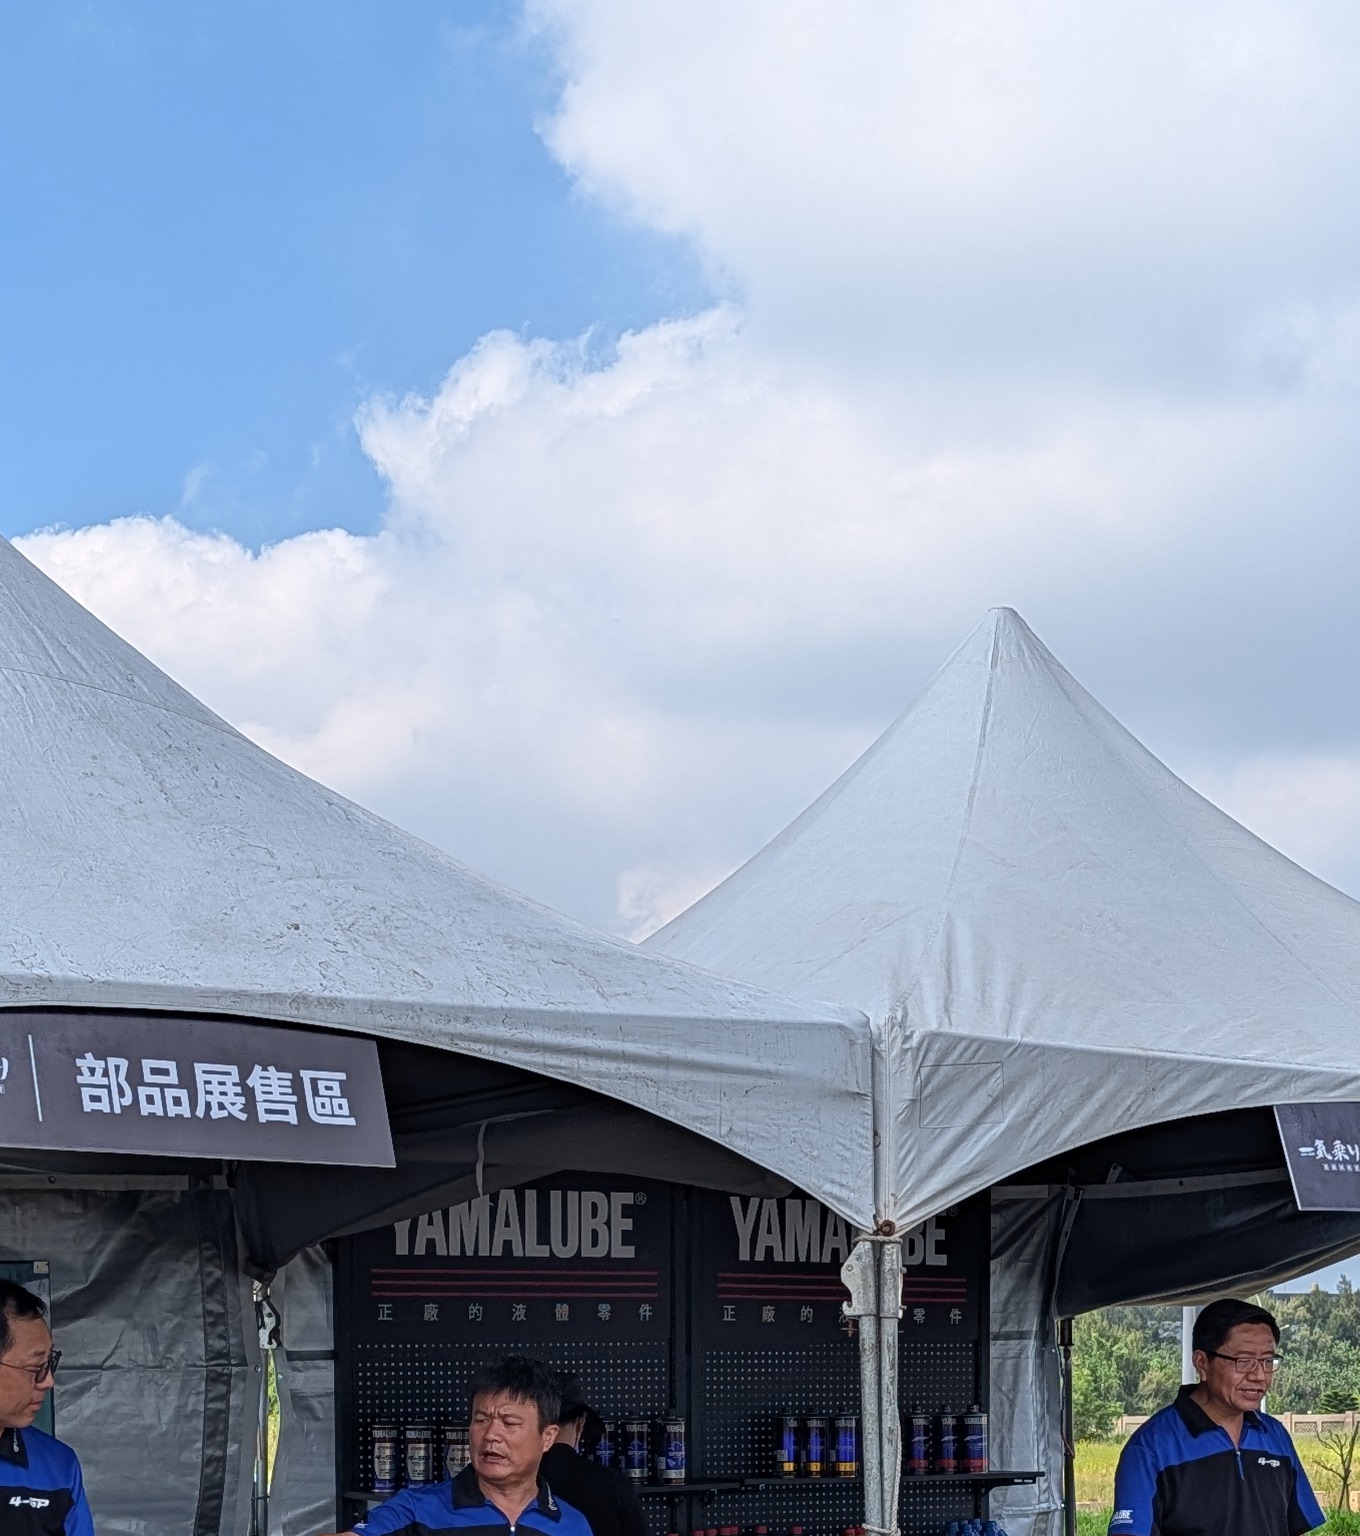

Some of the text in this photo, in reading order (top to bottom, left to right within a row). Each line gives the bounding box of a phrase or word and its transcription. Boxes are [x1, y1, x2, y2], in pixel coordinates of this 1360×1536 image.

[74, 1052, 357, 1127] 部品展售區
